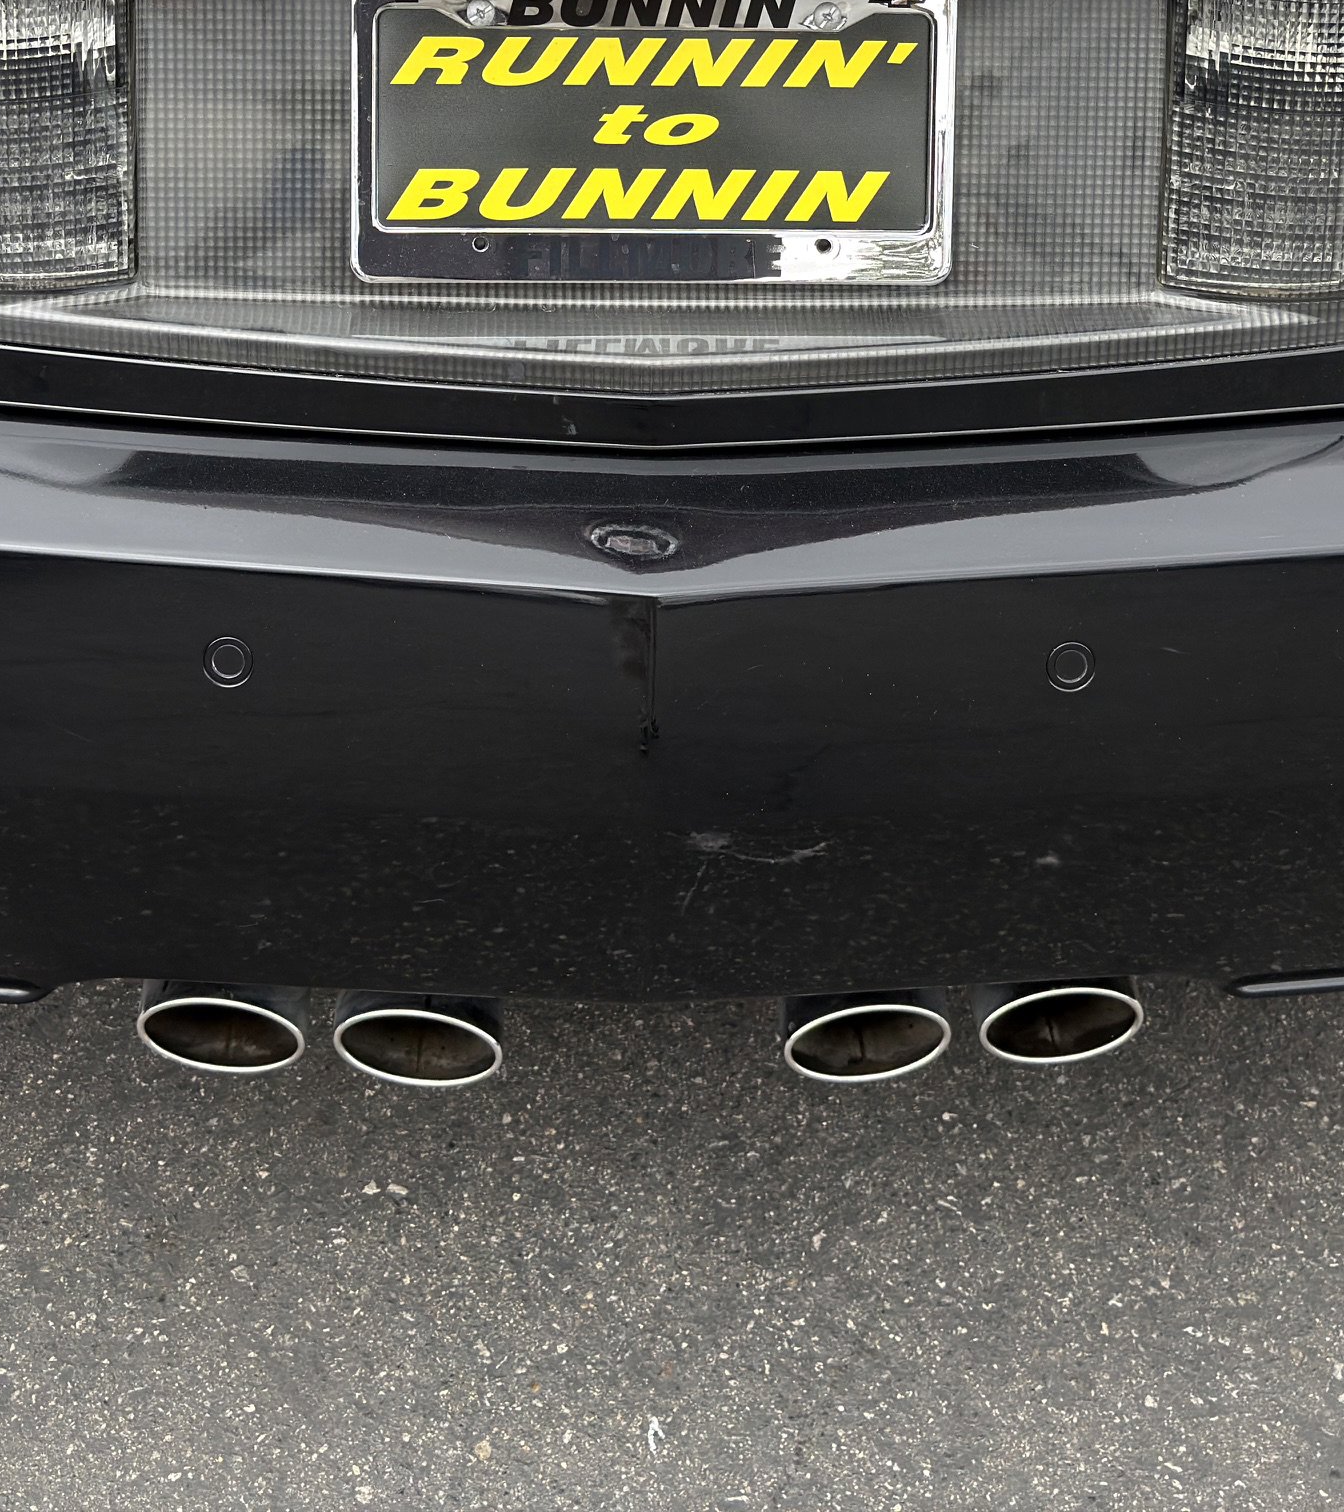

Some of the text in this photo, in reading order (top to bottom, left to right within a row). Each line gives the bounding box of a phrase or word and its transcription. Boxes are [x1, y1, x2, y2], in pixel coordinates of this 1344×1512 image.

[389, 35, 919, 88] RUNNIN'
[592, 104, 720, 146] to
[385, 167, 890, 223] BUNNIN
